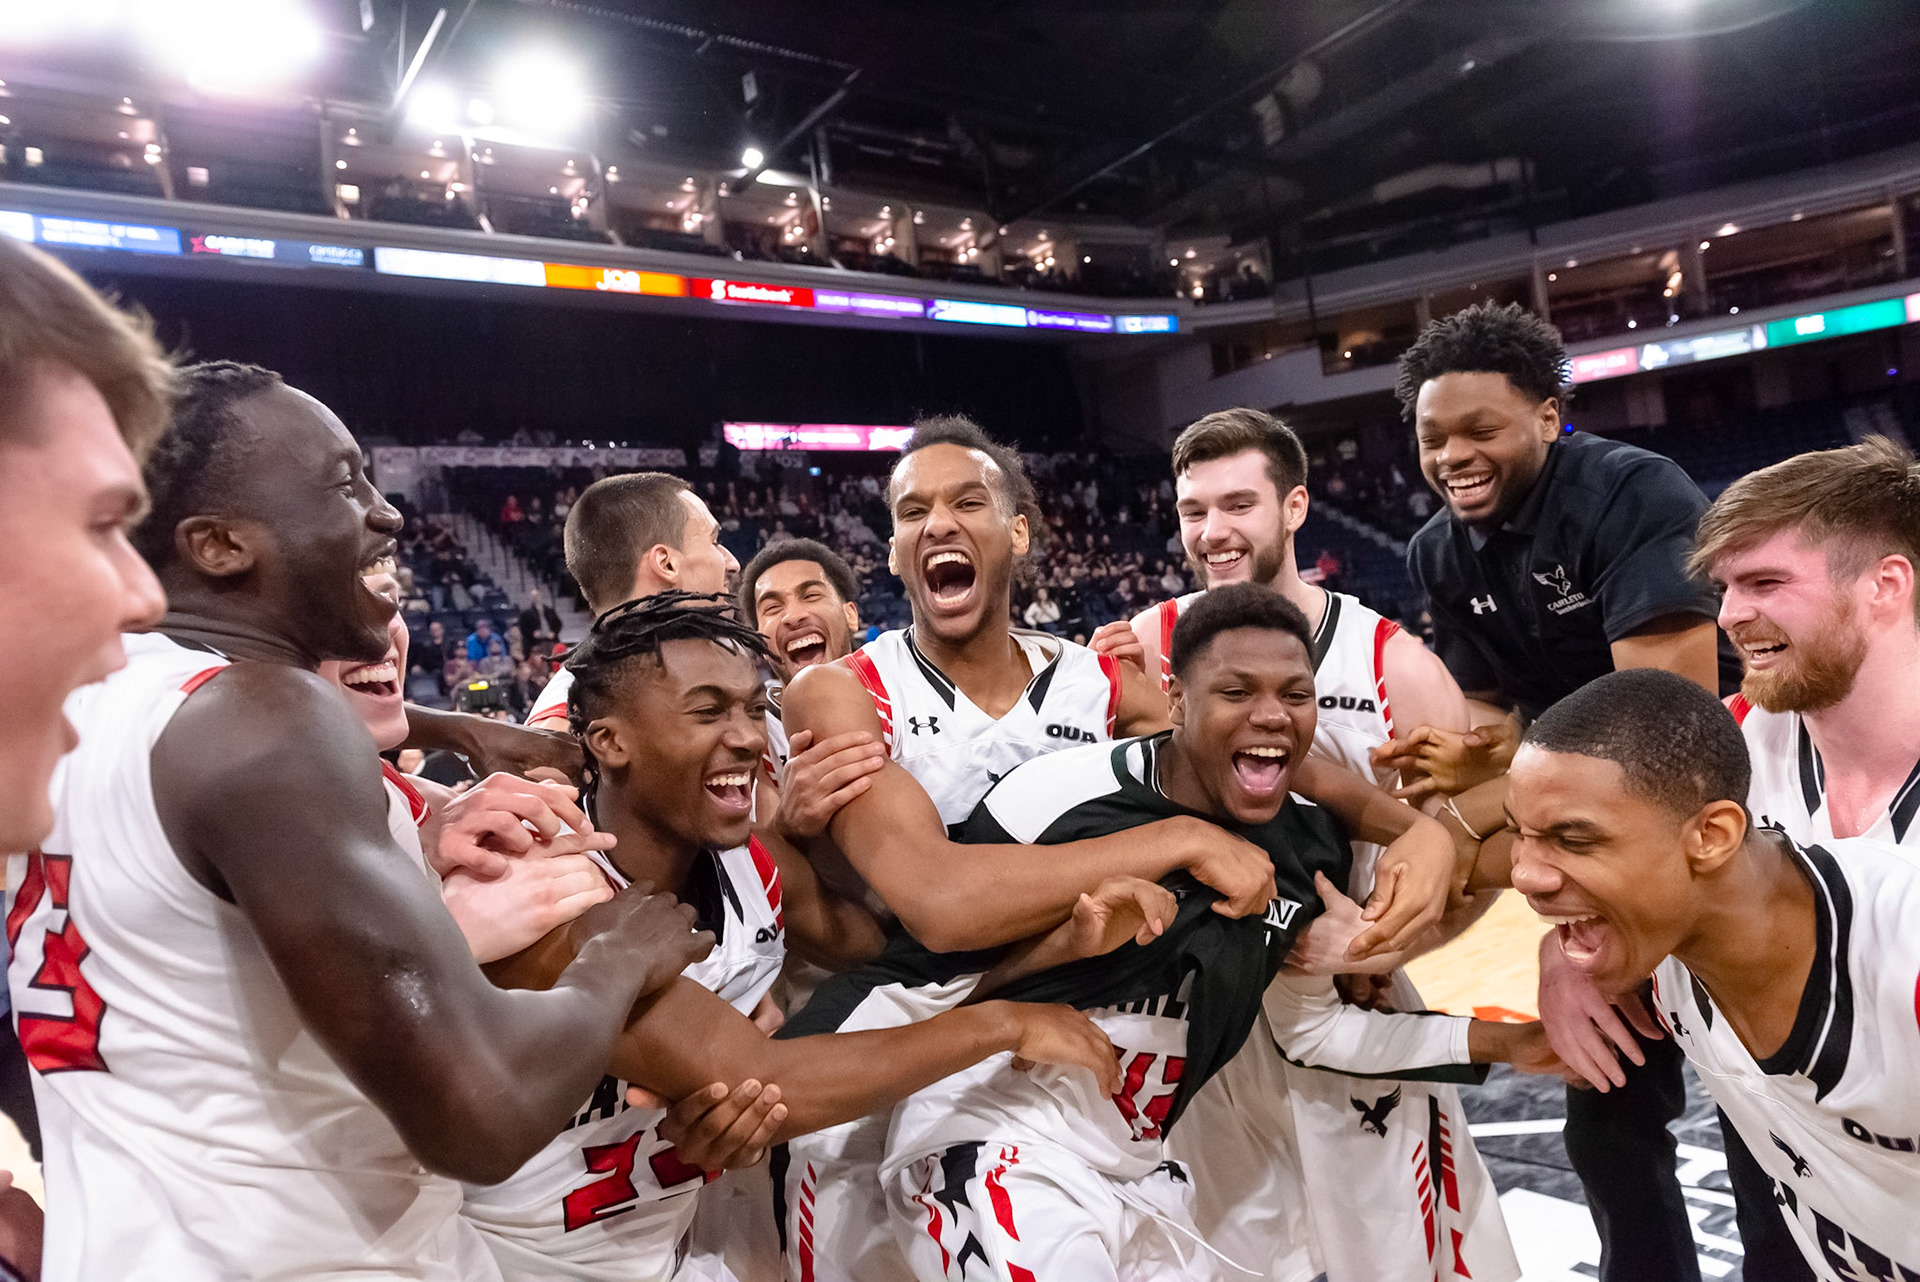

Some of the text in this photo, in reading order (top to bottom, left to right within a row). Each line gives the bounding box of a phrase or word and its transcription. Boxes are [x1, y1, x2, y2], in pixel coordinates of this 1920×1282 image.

[1318, 695, 1377, 714] OUA
[1045, 723, 1098, 744] OUA
[1841, 1116, 1920, 1154] OU
